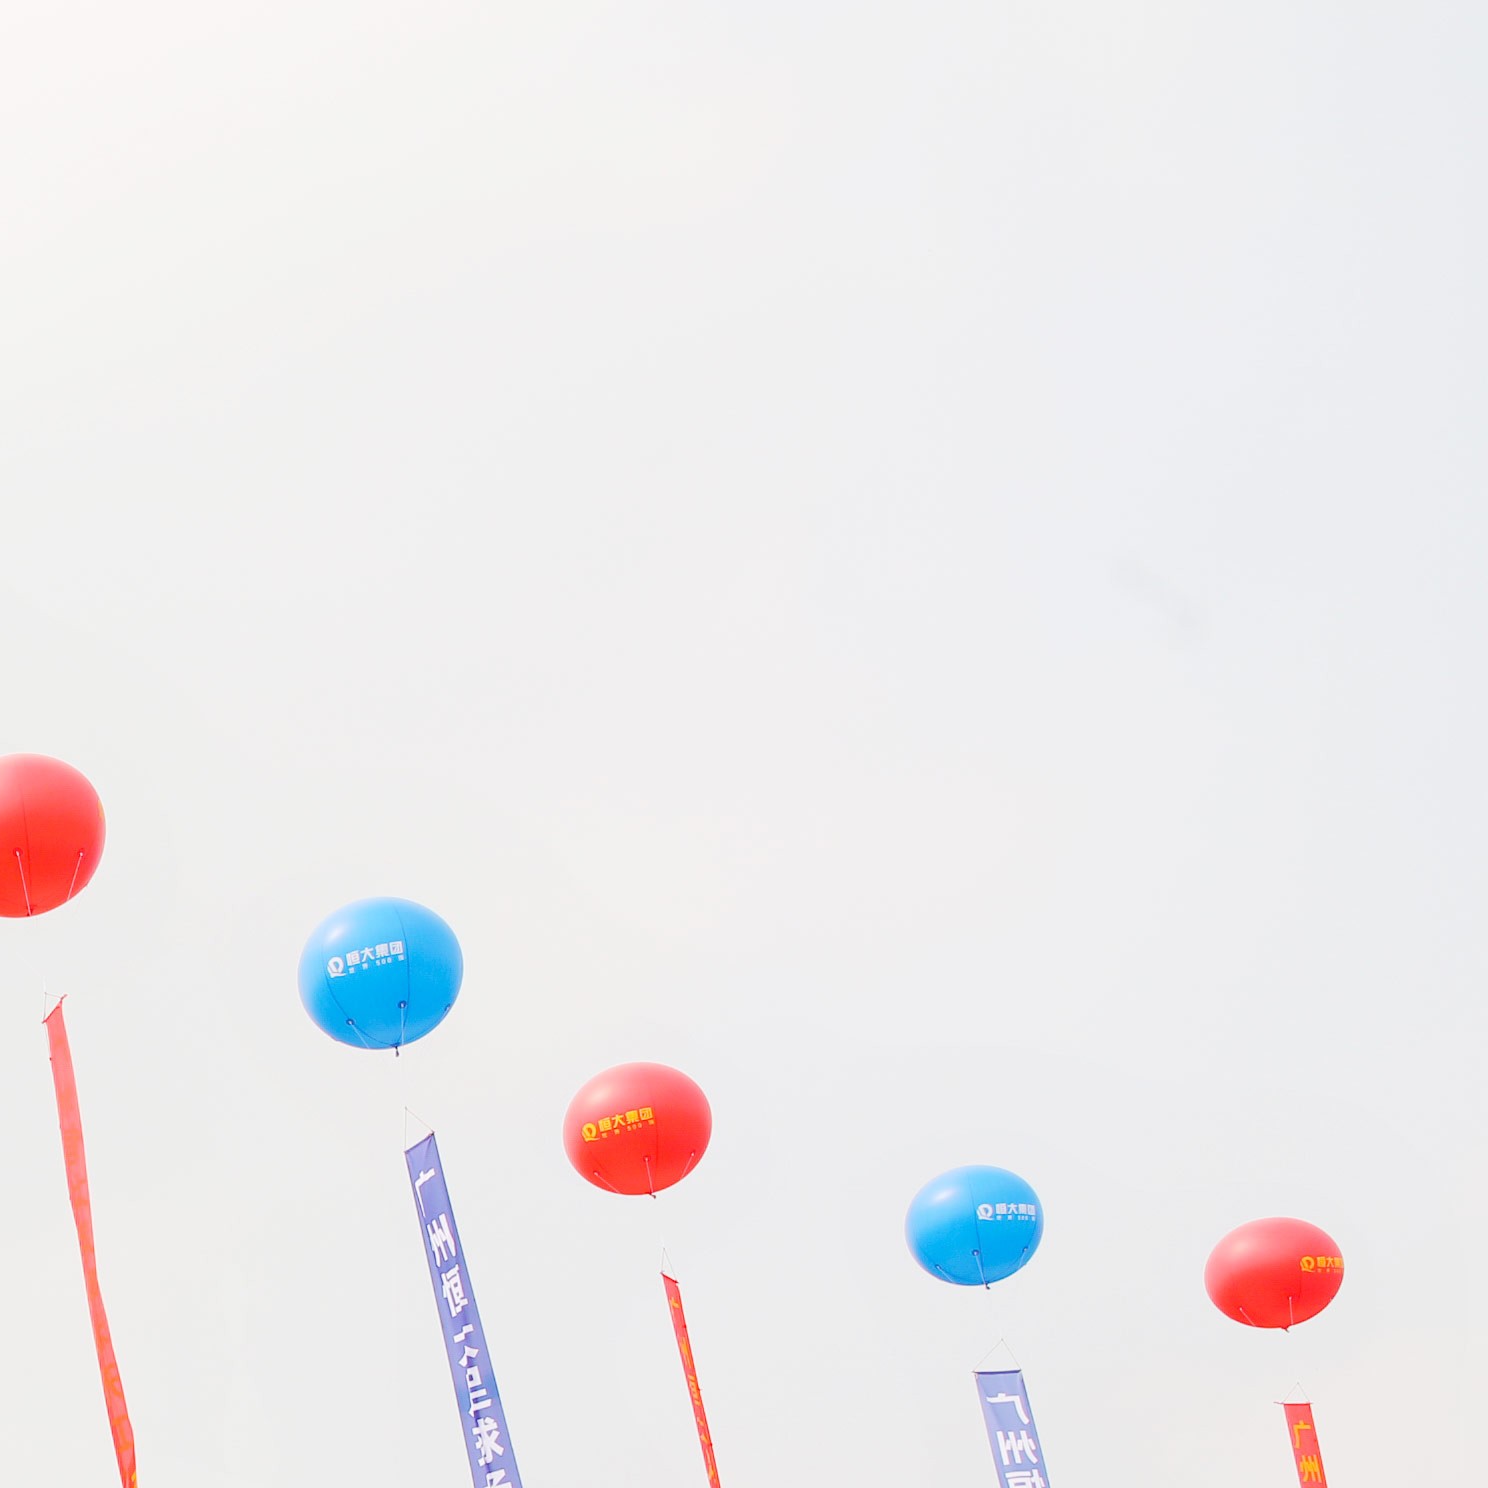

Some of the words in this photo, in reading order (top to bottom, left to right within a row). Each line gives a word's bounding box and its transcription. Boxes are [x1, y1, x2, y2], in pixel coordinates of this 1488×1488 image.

[346, 940, 404, 966] 恒大集团
[598, 1107, 654, 1133] 恒大集团
